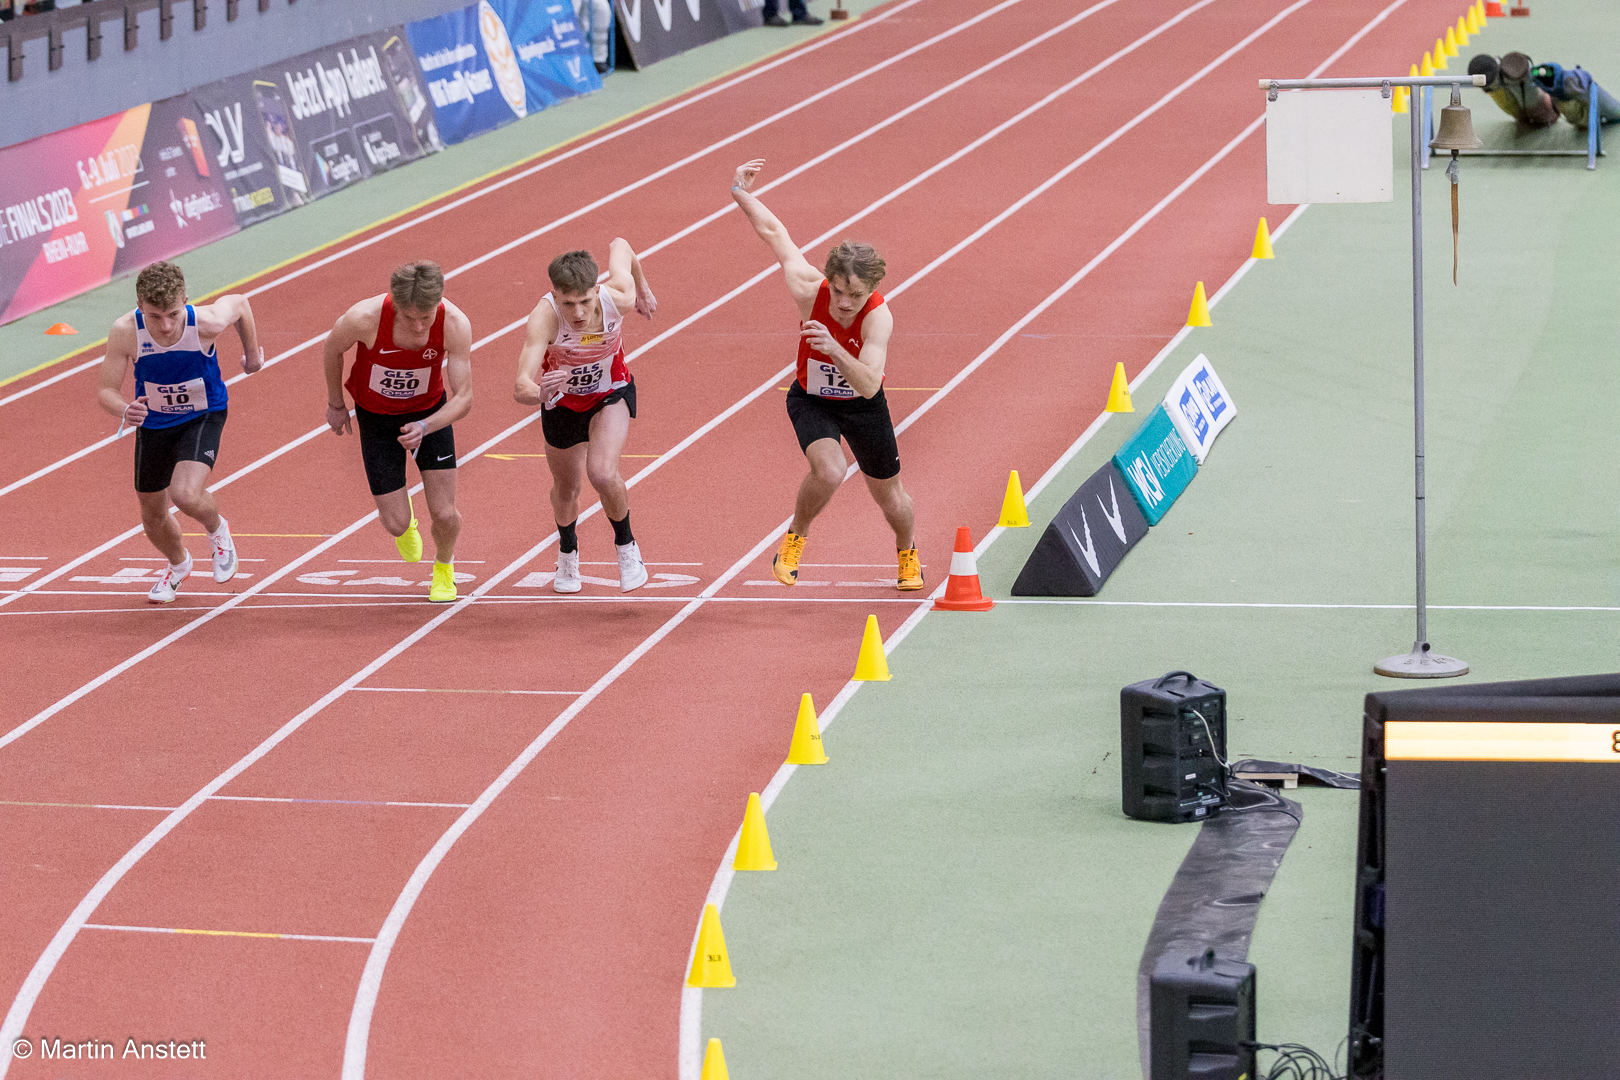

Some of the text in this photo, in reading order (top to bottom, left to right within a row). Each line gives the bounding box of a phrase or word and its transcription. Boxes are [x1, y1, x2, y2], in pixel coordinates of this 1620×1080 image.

[284, 71, 327, 120] Jetzt
[315, 61, 352, 118] App
[337, 45, 388, 100] laden!
[114, 143, 144, 177] 2023
[6, 195, 53, 242] FINALS
[45, 187, 78, 228] 2023
[384, 370, 414, 378] GLS
[571, 363, 599, 375] GLS
[820, 365, 839, 374] GL
[380, 378, 419, 389] 450
[566, 369, 603, 386] 493
[825, 373, 850, 388] 12
[157, 385, 187, 394] GLS
[163, 394, 190, 405] 10
[1127, 450, 1166, 509] WGV
